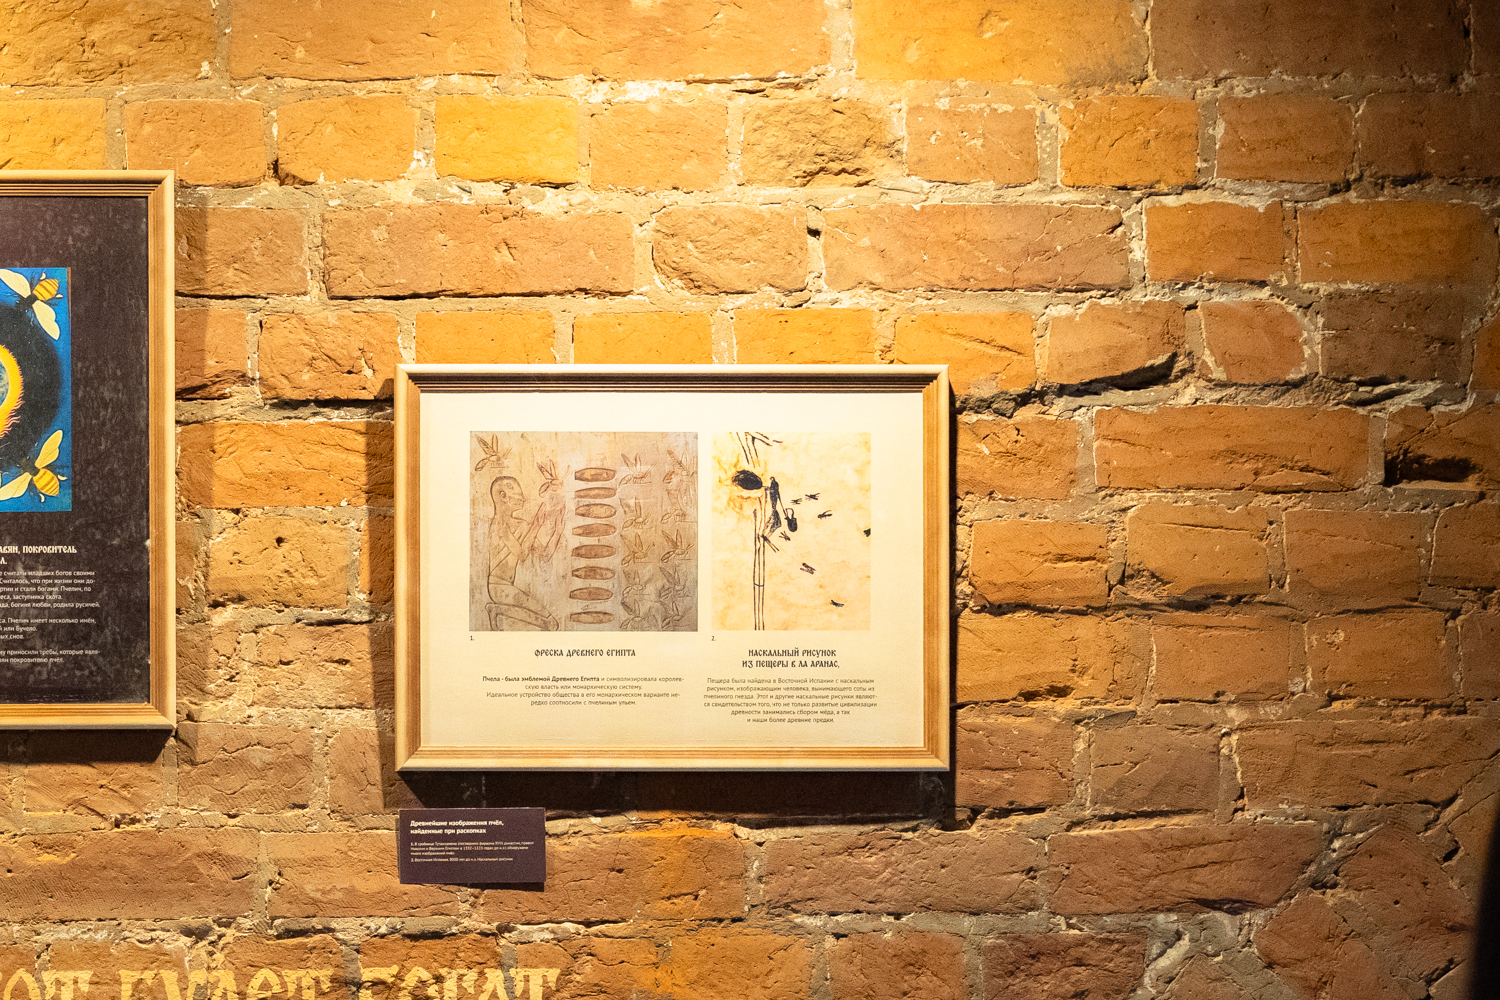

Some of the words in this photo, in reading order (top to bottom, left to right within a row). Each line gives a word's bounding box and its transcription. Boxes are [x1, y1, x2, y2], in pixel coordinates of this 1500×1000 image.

[23, 546, 77, 554] ПОКРОВИТЕЛЬ
[534, 649, 564, 657] ФРЕСКА
[566, 649, 604, 657] ДРЕВНЕГО
[606, 649, 636, 657] ЕГИПТА
[748, 647, 799, 657] НАСКАЛЬНЫЙ
[802, 649, 836, 658] РИСУНОК
[742, 660, 753, 668] ИЗ
[756, 660, 788, 669] ПЕЩЕРЫ
[810, 660, 840, 668] АРАНАС,
